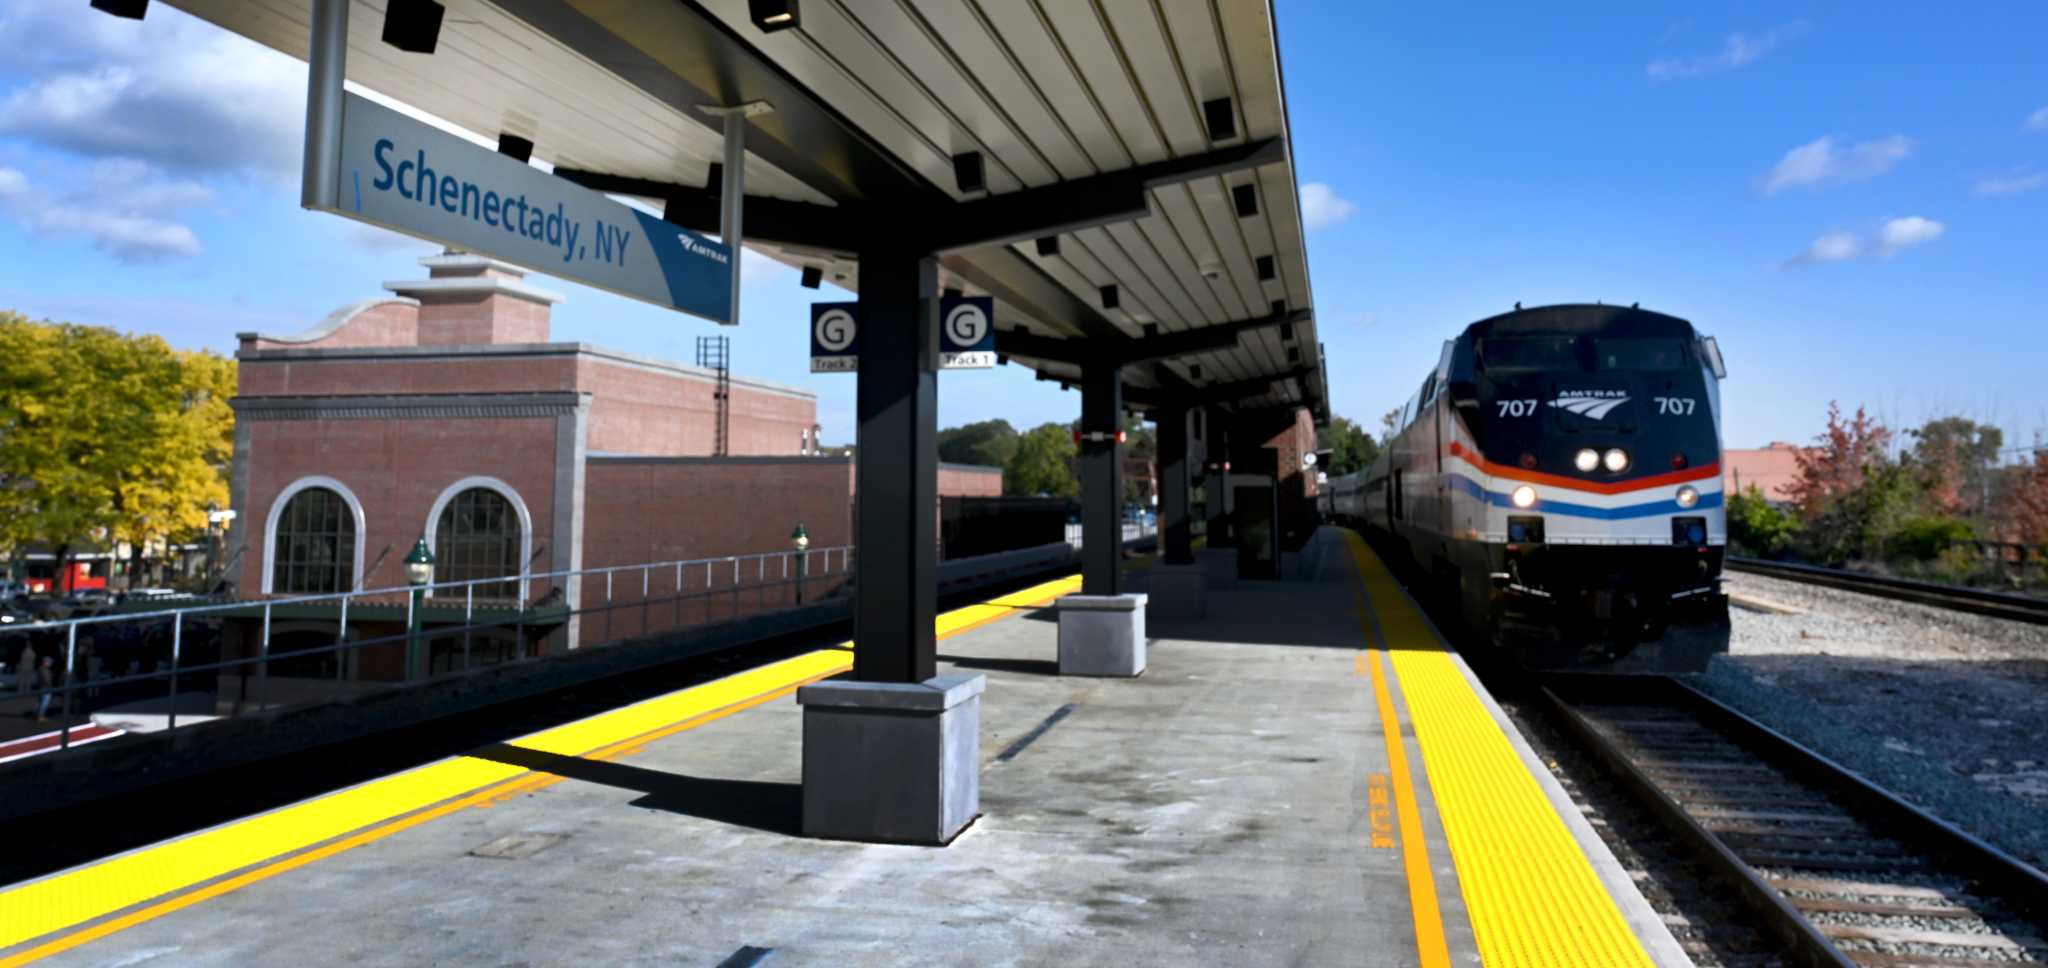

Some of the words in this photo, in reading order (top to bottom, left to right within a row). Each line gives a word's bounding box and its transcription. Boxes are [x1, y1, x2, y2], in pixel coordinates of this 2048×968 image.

[373, 138, 585, 263] Schenectady,
[595, 220, 631, 267] NY
[692, 243, 728, 264] AMTRAK
[823, 315, 845, 344] G
[953, 310, 976, 340] G
[815, 357, 847, 369] Track
[945, 354, 977, 365] Track
[983, 354, 988, 364] 1
[1559, 389, 1626, 398] AMTRAK
[1496, 399, 1538, 418] 707
[1654, 397, 1696, 416] 707
